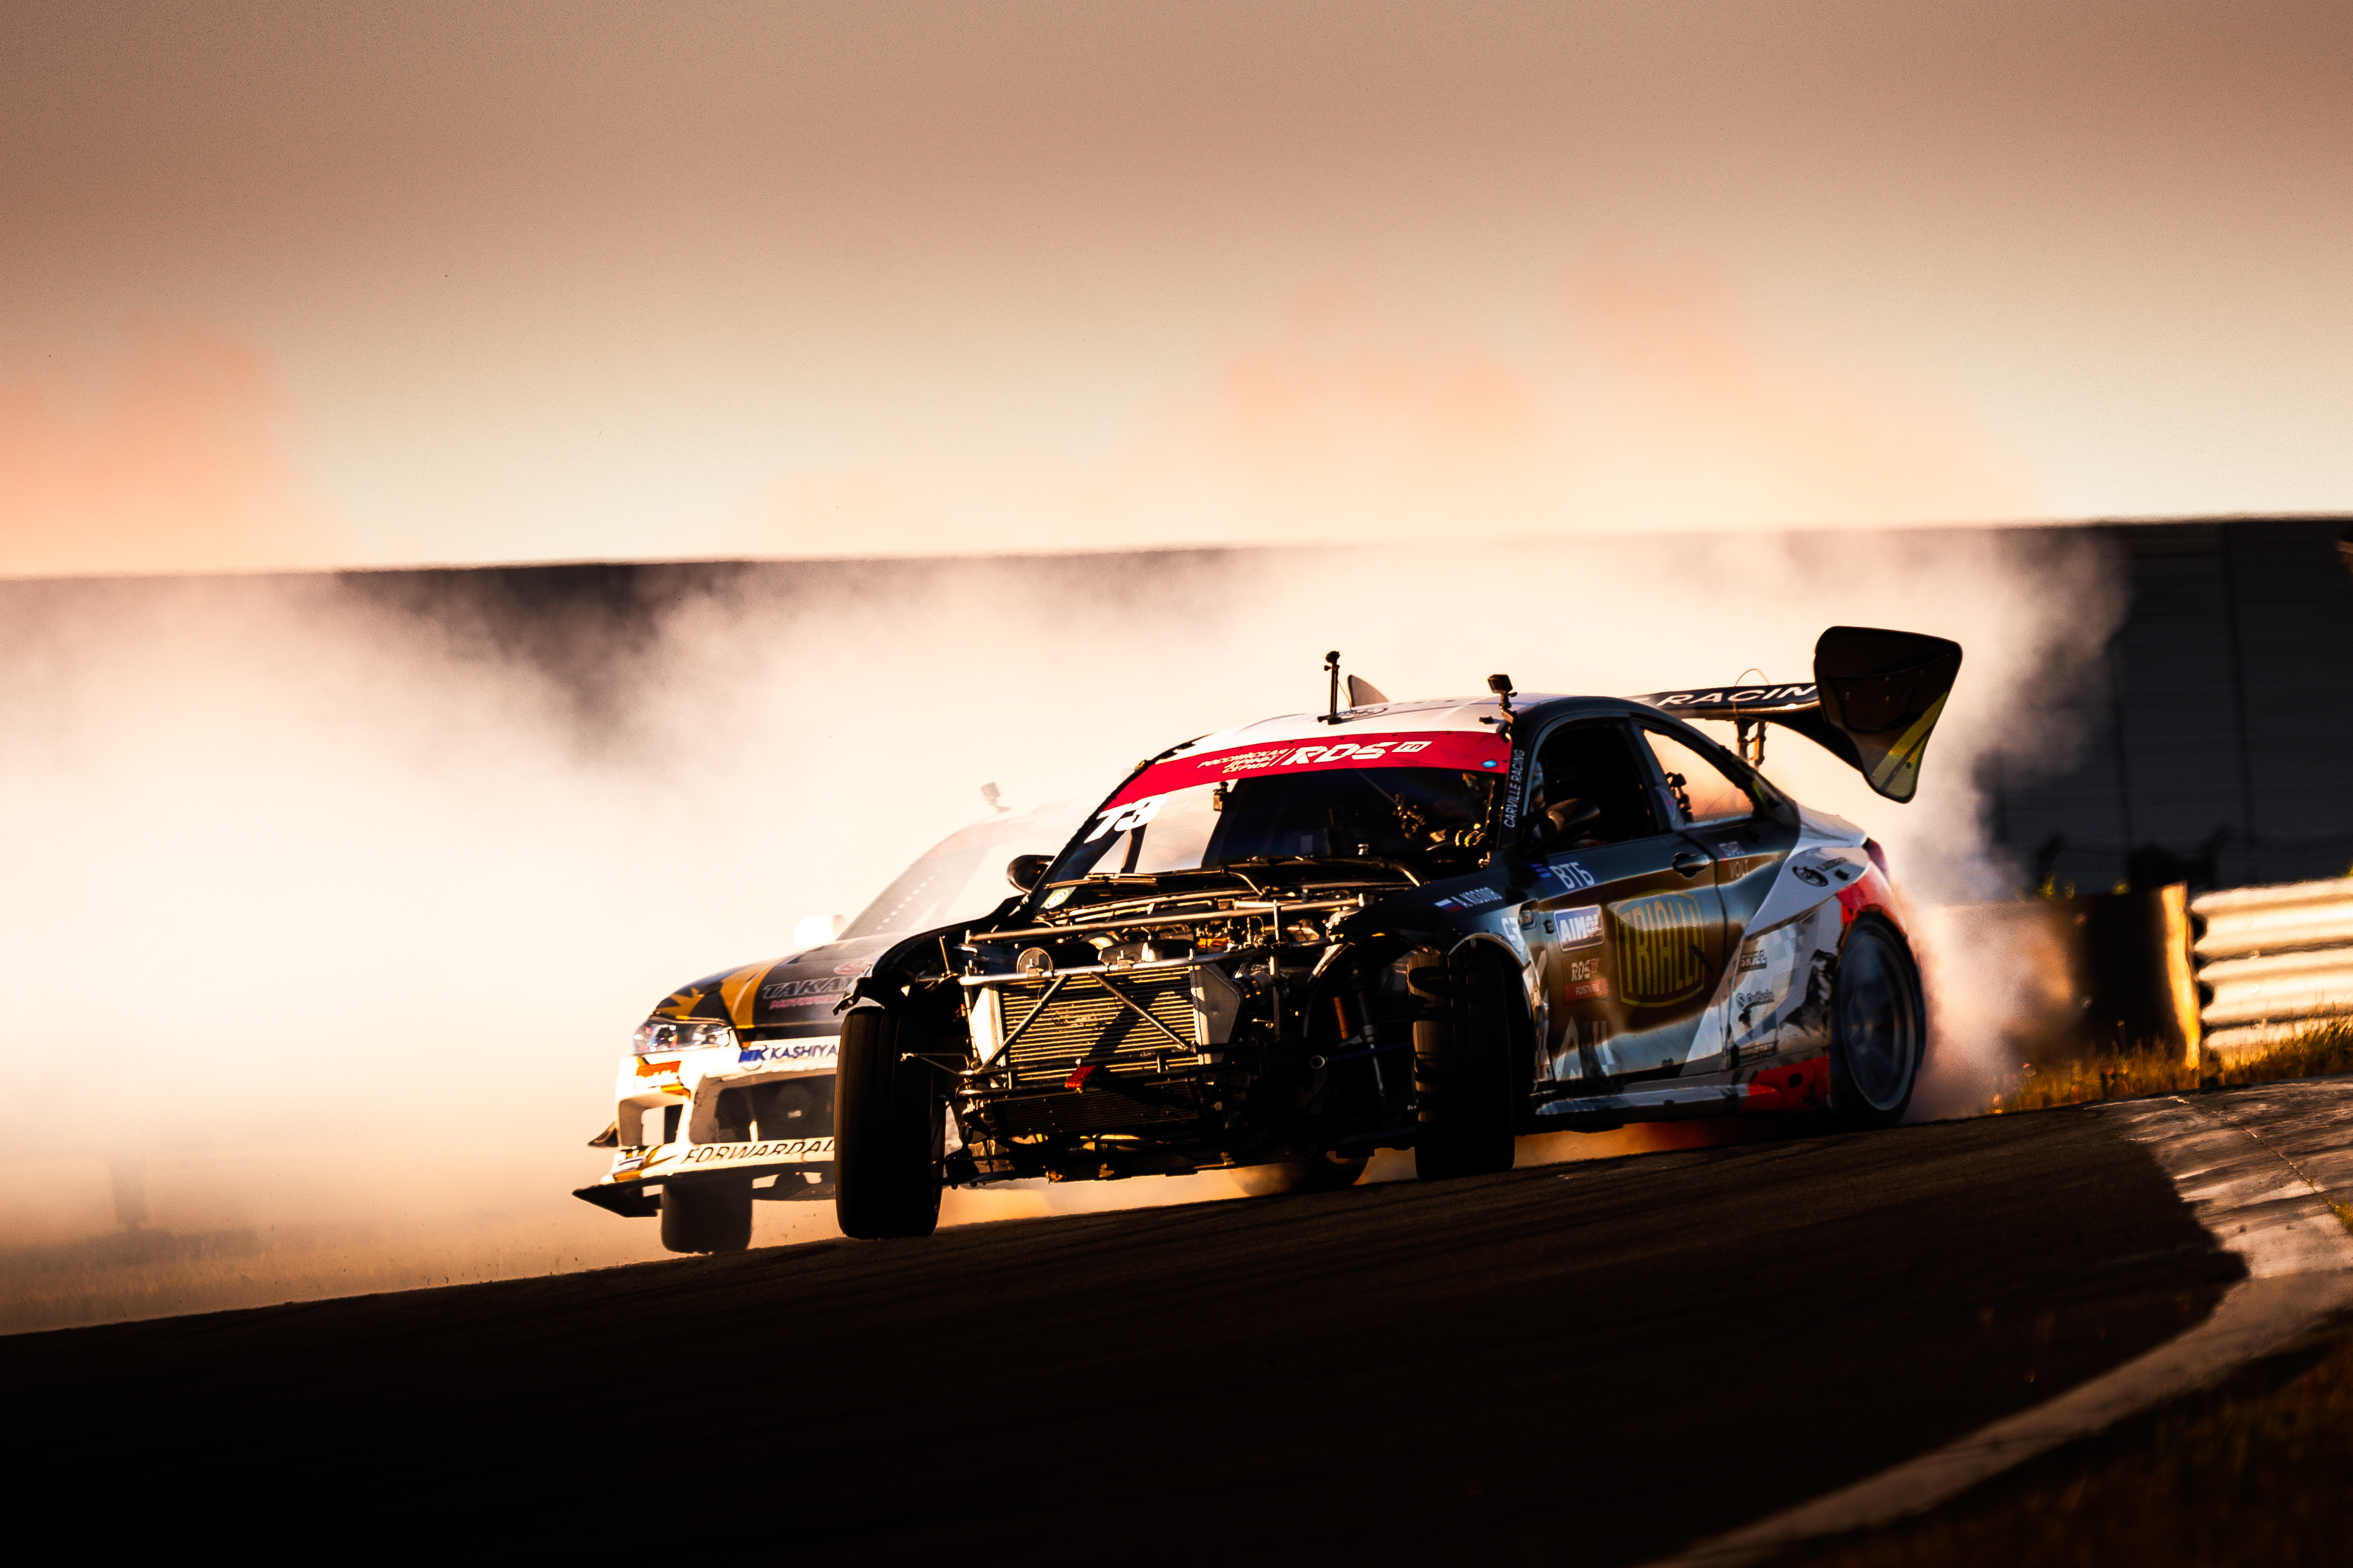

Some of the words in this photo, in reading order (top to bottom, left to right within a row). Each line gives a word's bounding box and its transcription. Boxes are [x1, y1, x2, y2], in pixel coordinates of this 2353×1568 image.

[1281, 741, 1400, 766] RDS
[1511, 749, 1525, 783] RACING
[1504, 783, 1521, 828] CARVILLE
[1549, 862, 1595, 889] ВТБ
